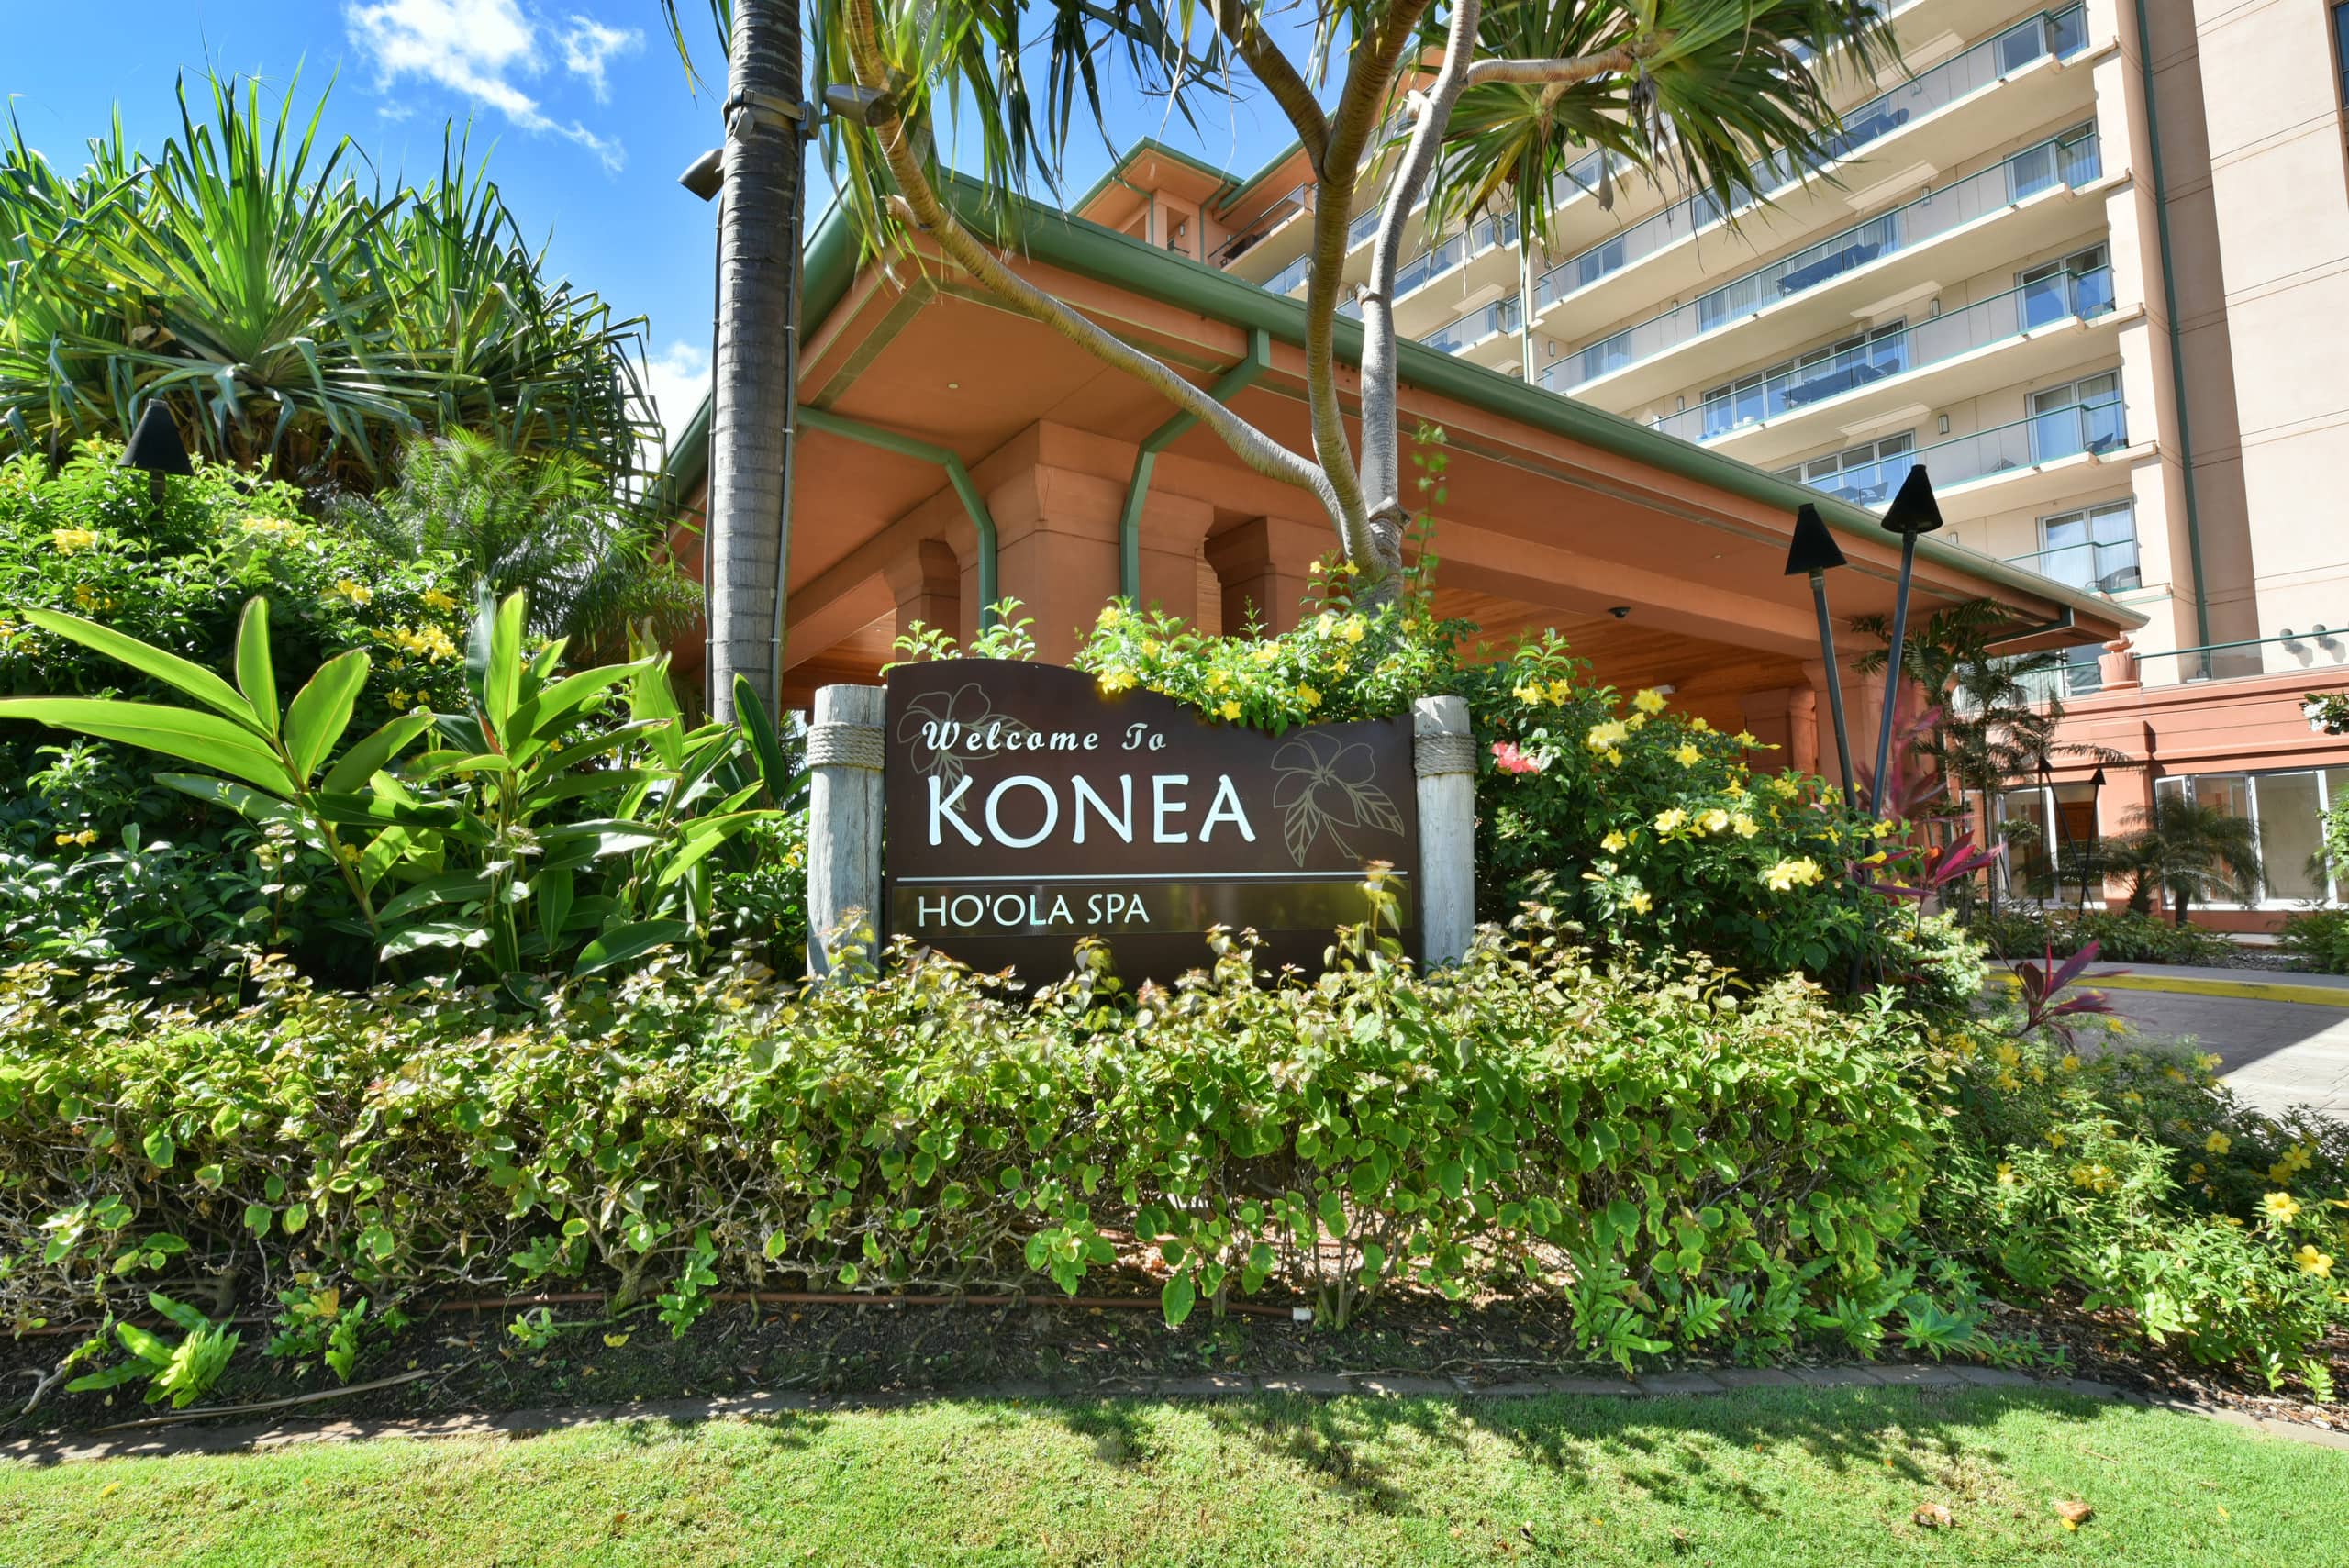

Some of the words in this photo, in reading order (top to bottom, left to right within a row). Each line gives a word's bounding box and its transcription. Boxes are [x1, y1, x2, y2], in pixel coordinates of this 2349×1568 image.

[922, 720, 1098, 751] Welcome
[1122, 722, 1167, 751] To
[927, 773, 1257, 849] KONEA
[1087, 893, 1150, 925] SPA
